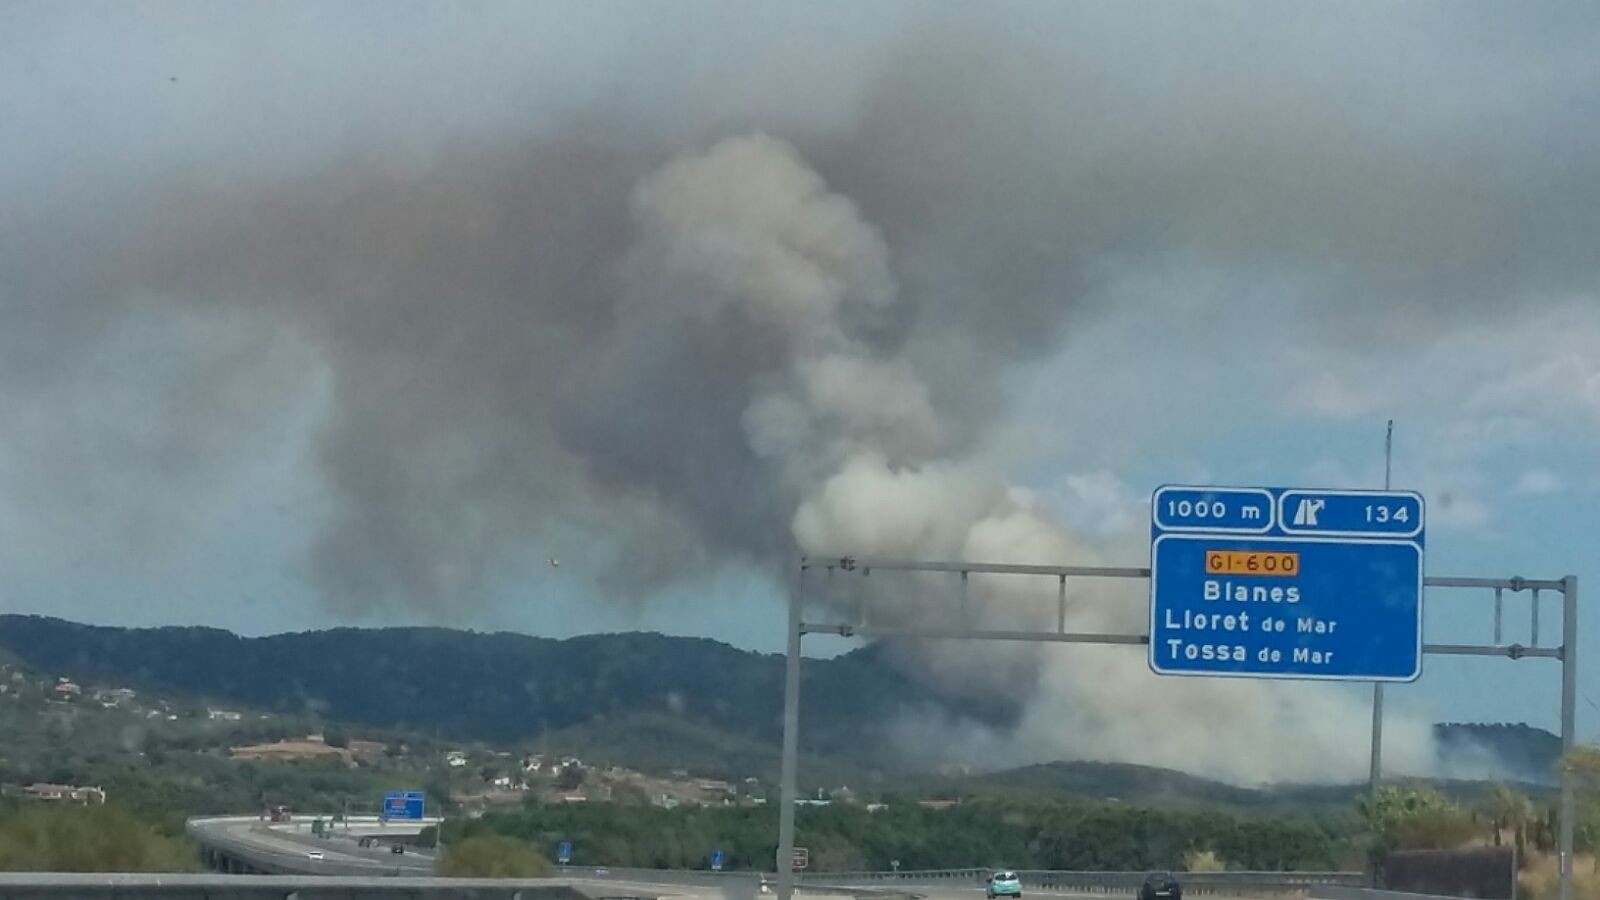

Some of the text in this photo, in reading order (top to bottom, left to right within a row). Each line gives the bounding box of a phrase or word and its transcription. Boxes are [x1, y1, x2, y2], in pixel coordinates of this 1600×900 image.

[1168, 500, 1260, 520] 1000 m
[1365, 505, 1409, 523] 134
[1209, 554, 1295, 572] GI-600
[1204, 580, 1301, 603] Blanes
[1165, 608, 1337, 634] Lloret de Mar
[1167, 639, 1334, 665] Tossa de Mar
